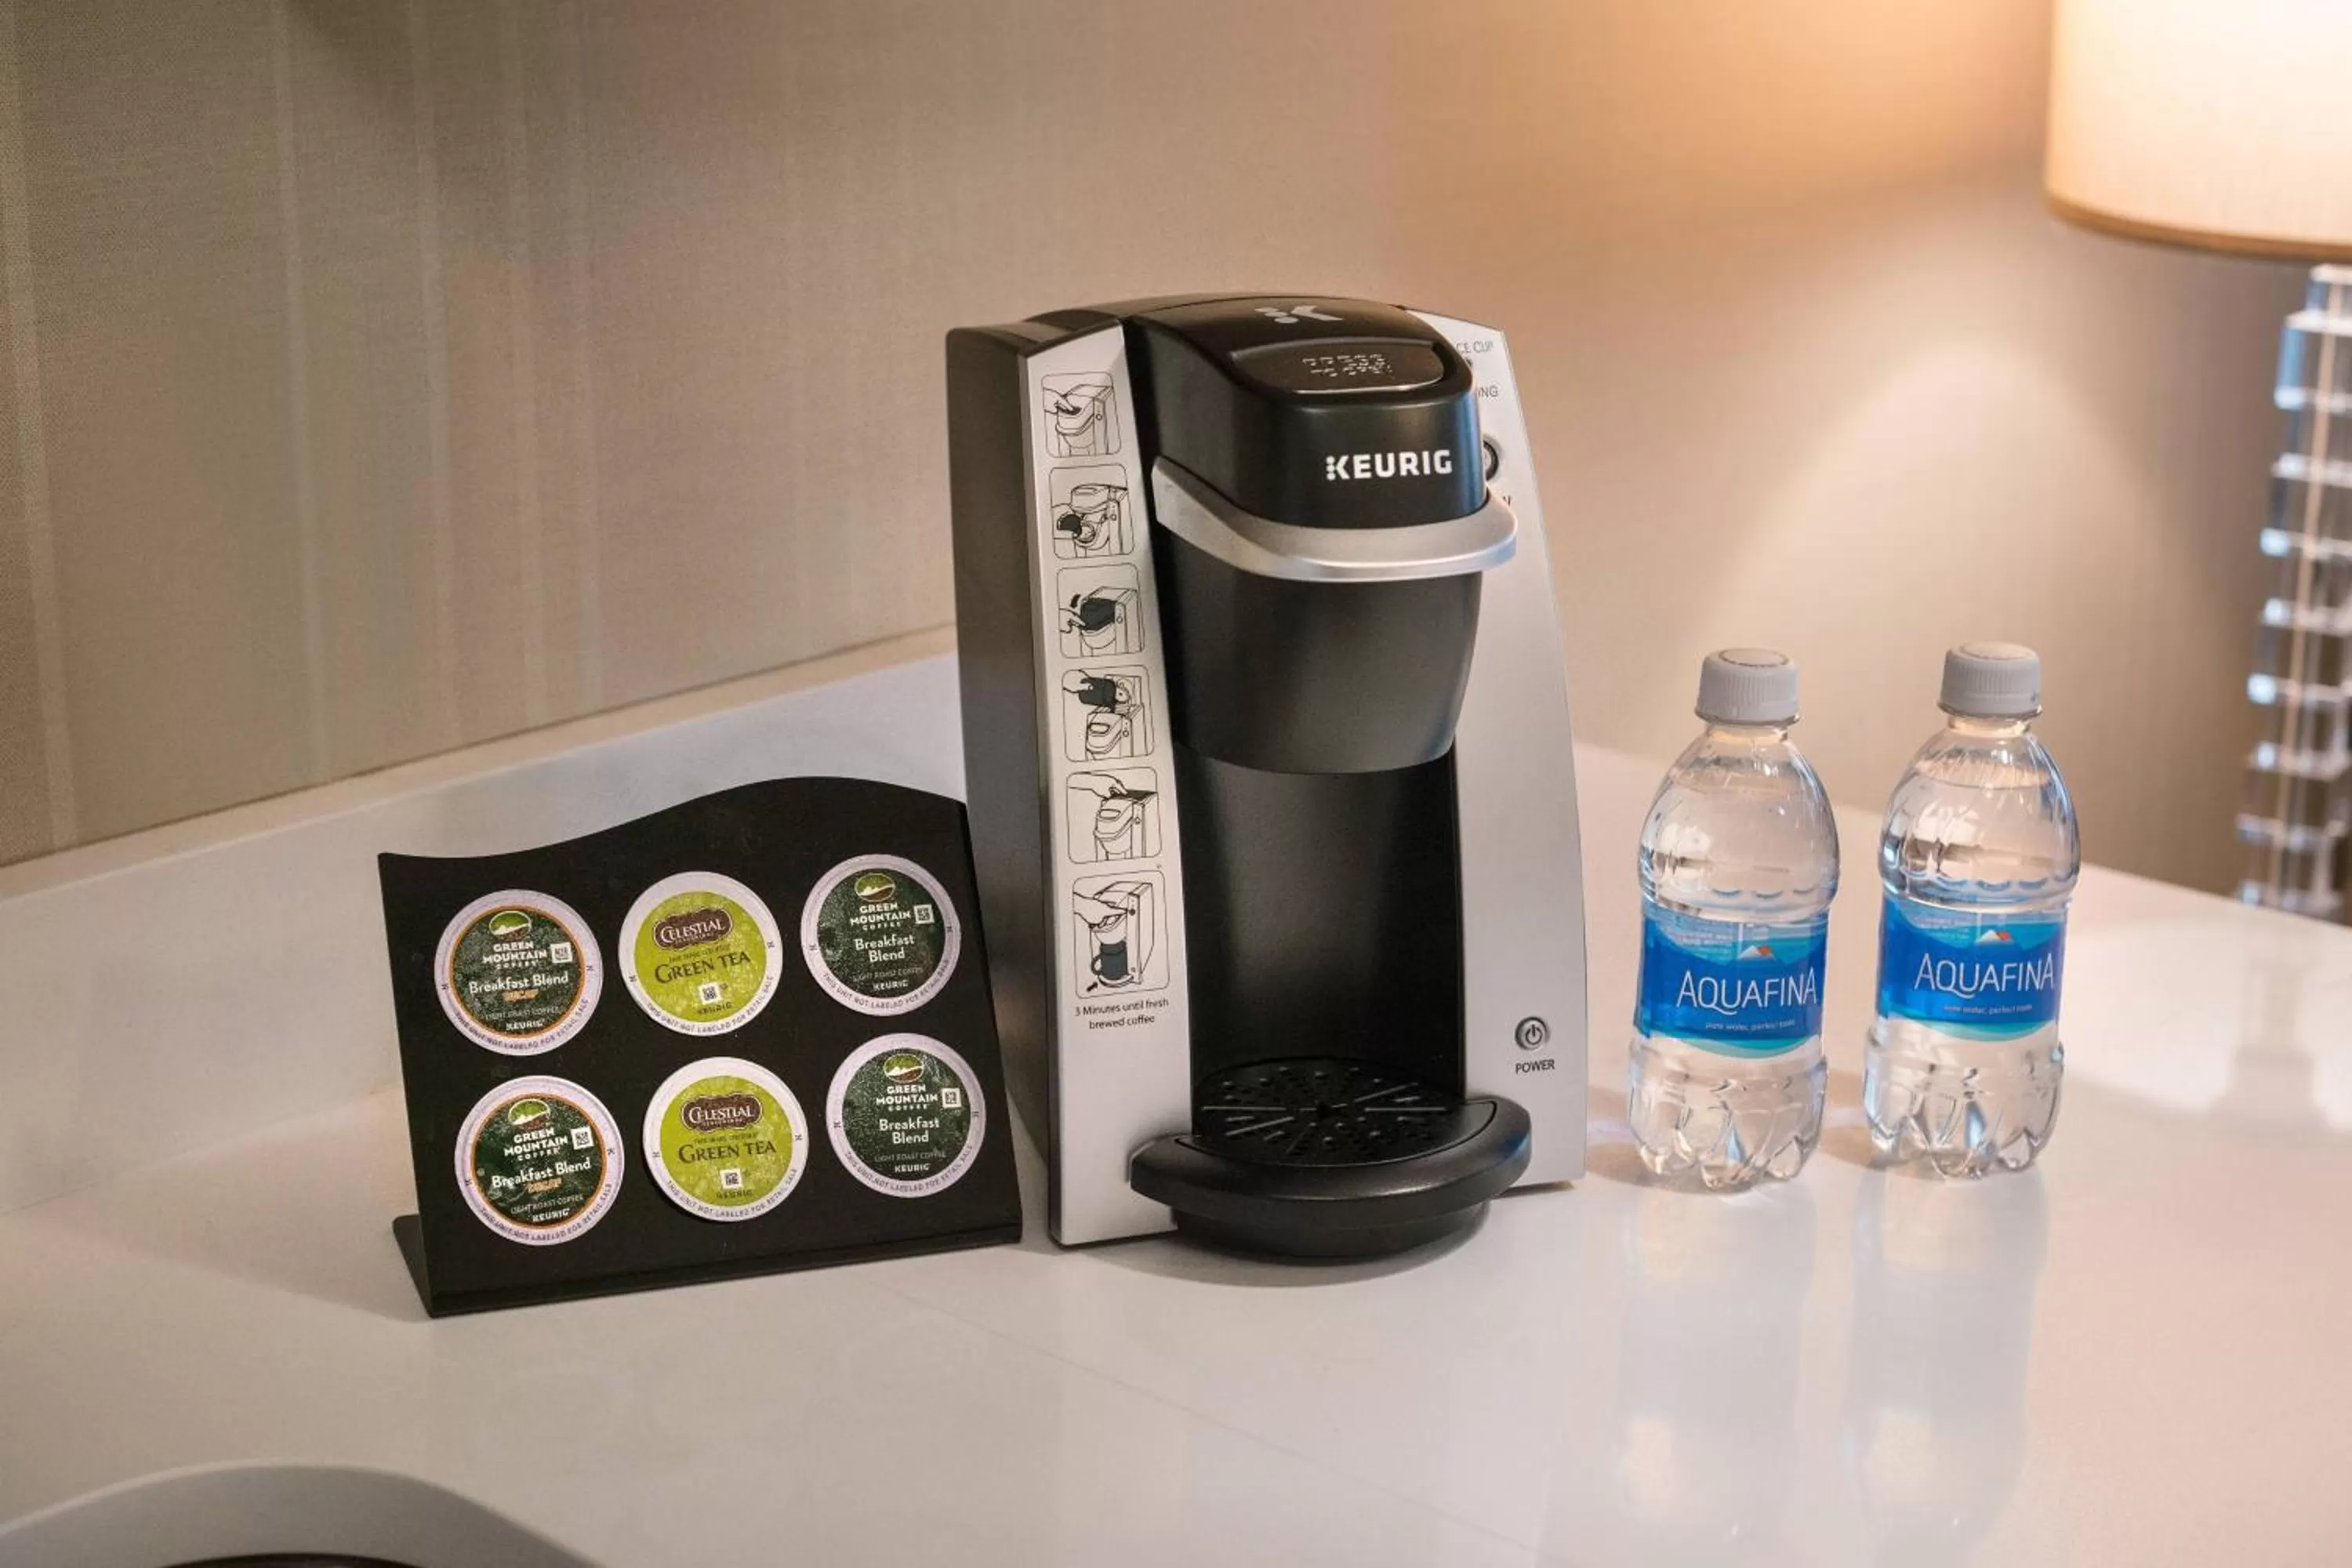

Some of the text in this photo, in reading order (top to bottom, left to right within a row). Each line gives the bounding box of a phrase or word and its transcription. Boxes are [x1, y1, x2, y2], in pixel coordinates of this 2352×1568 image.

[1326, 449, 1453, 481] KEURIG
[859, 903, 898, 913] GREEN
[850, 911, 911, 926] MOUNTAIN
[660, 919, 727, 943] CELESTIAL
[493, 941, 534, 952] GREEN
[855, 934, 915, 951] Breakfast
[483, 950, 547, 964] MOUNTAIN
[868, 948, 906, 963] Blend
[655, 958, 714, 984] GREEN
[718, 951, 751, 967] TEA
[1915, 953, 2055, 999] AQUAFINA
[469, 971, 568, 994] Breakfast Blend
[1676, 967, 1818, 1015] AQUAFINA
[1075, 997, 1169, 1016] 3 Minutes until fresh
[1088, 1014, 1155, 1029] brewed coffee
[1515, 1058, 1555, 1074] POWER
[887, 1084, 927, 1094] GREEN
[876, 1093, 938, 1105] MOUNTAIN
[688, 1105, 755, 1123] CELESTIAL
[879, 1116, 940, 1131] Breakfast
[514, 1127, 554, 1144] GREEN
[892, 1131, 929, 1145] Blend
[504, 1135, 568, 1157] MOUNTAIN
[678, 1141, 777, 1163] GREEN TEA
[492, 1156, 590, 1189] Breakfast Blend
[895, 1163, 931, 1173] KEURIG
